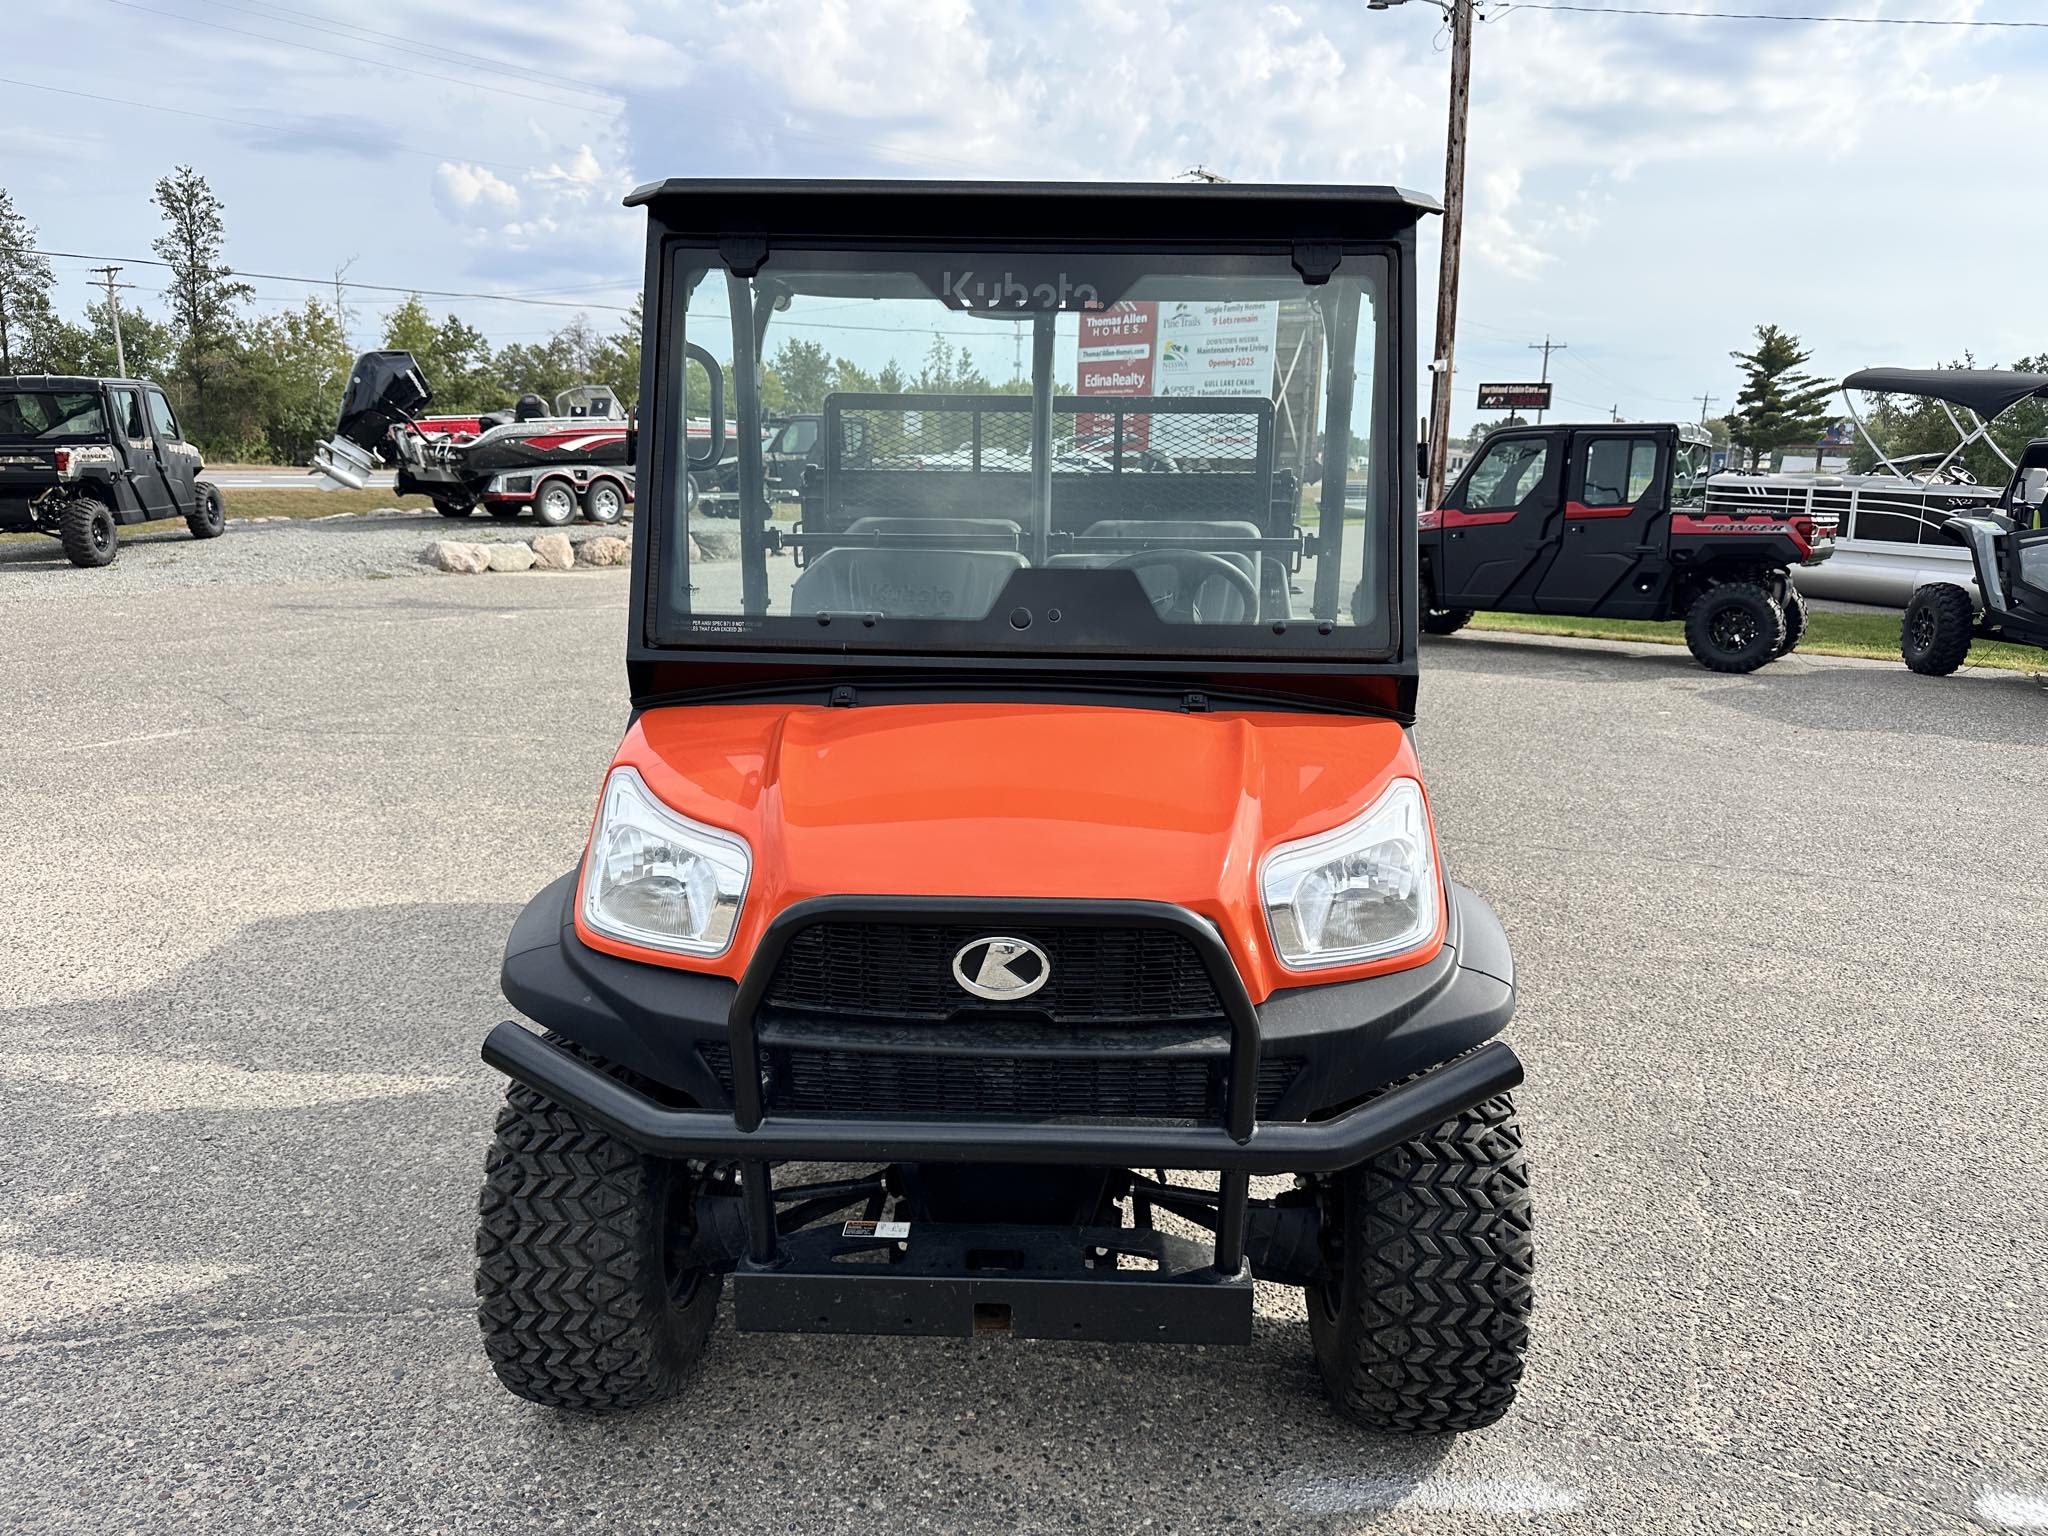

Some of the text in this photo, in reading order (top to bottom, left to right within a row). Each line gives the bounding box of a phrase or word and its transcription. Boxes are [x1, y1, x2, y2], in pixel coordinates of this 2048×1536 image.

[943, 271, 1098, 309] Kubota
[1224, 304, 1244, 313] Family
[1087, 313, 1148, 327] Thomas Allen
[1163, 317, 1201, 328] Pine Trails
[1212, 315, 1258, 326] 9 Lots remain
[1092, 324, 1139, 336] HOMES
[1197, 346, 1234, 354] Maintenance
[1249, 344, 1269, 353] Living
[1208, 357, 1255, 368] Opening 2025
[1220, 379, 1235, 387] LAKE
[1236, 378, 1255, 386] CHAIN
[1201, 388, 1227, 396] Beautiful
[1946, 497, 1973, 506] SX22
[1711, 524, 1785, 532] RANGER
